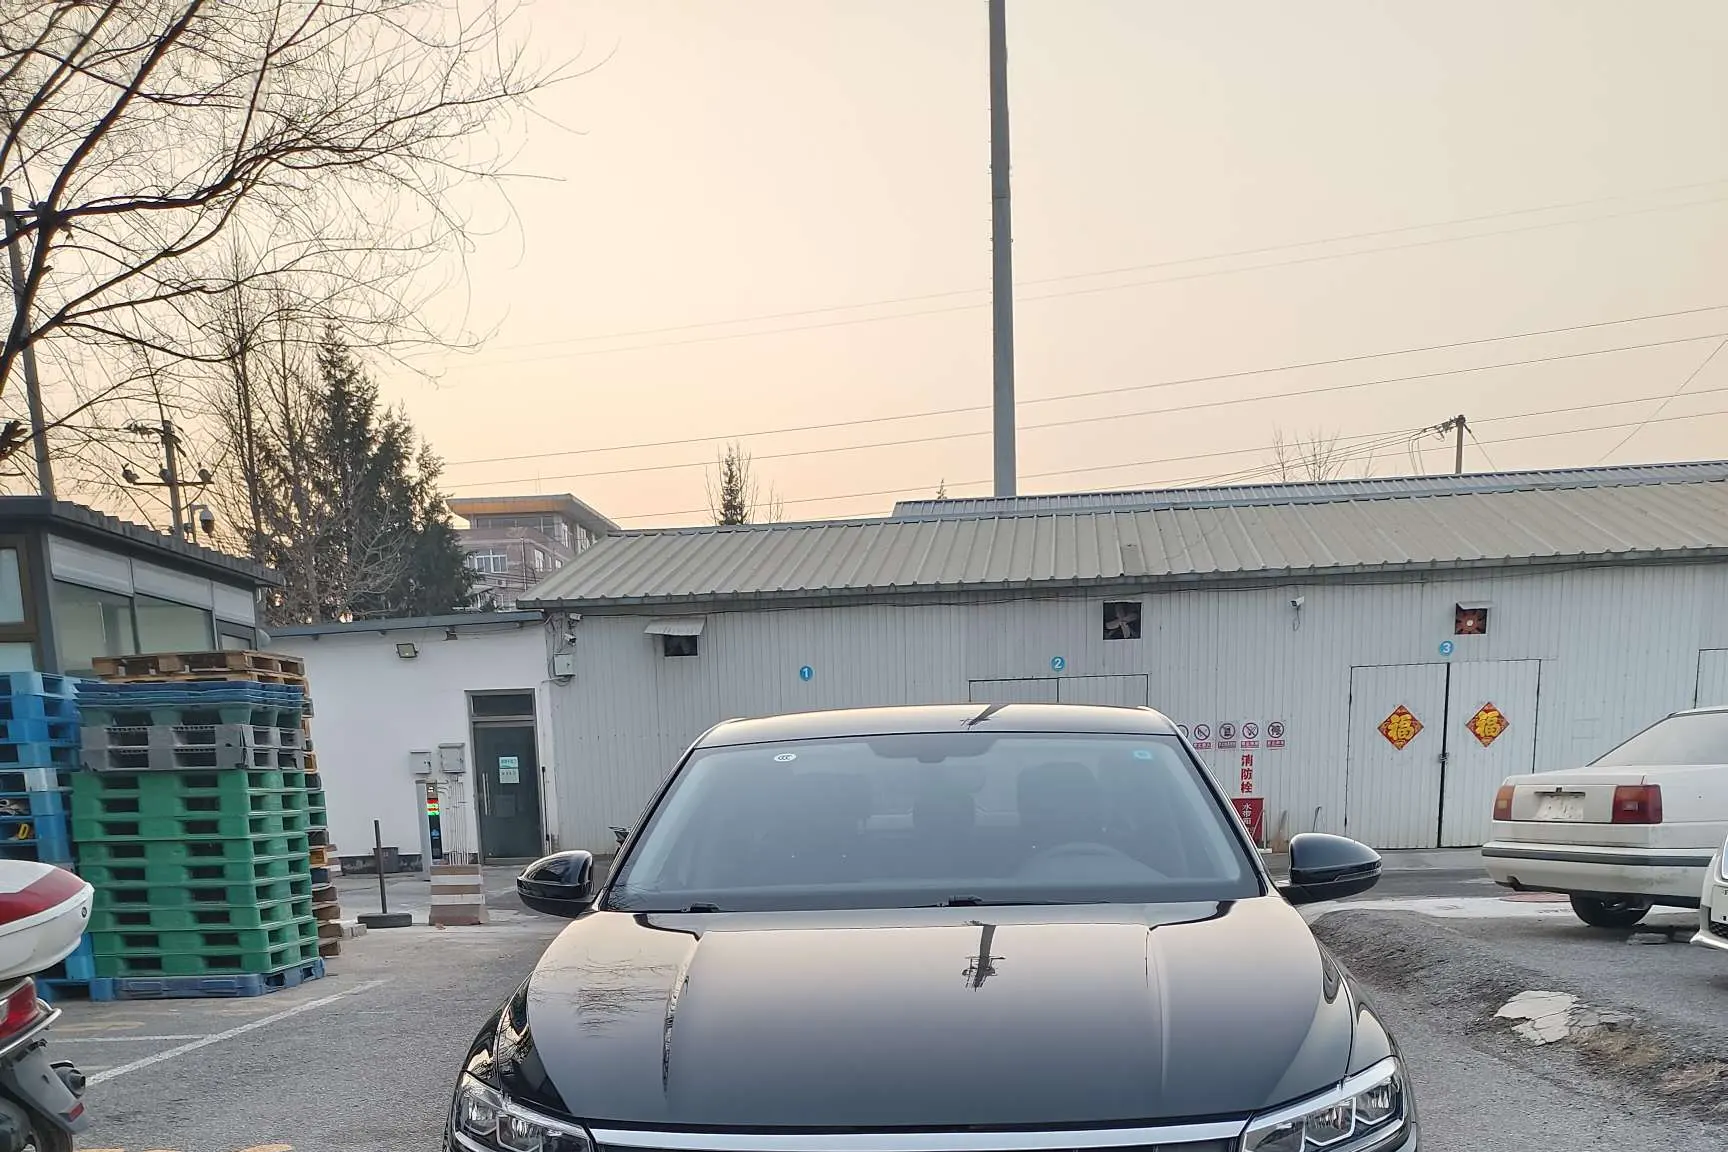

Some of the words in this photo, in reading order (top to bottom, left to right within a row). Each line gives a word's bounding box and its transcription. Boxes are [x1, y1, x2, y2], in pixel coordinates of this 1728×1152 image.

[1387, 713, 1416, 741] 福
[1474, 710, 1501, 737] 福
[1240, 754, 1253, 793] 消防栓
